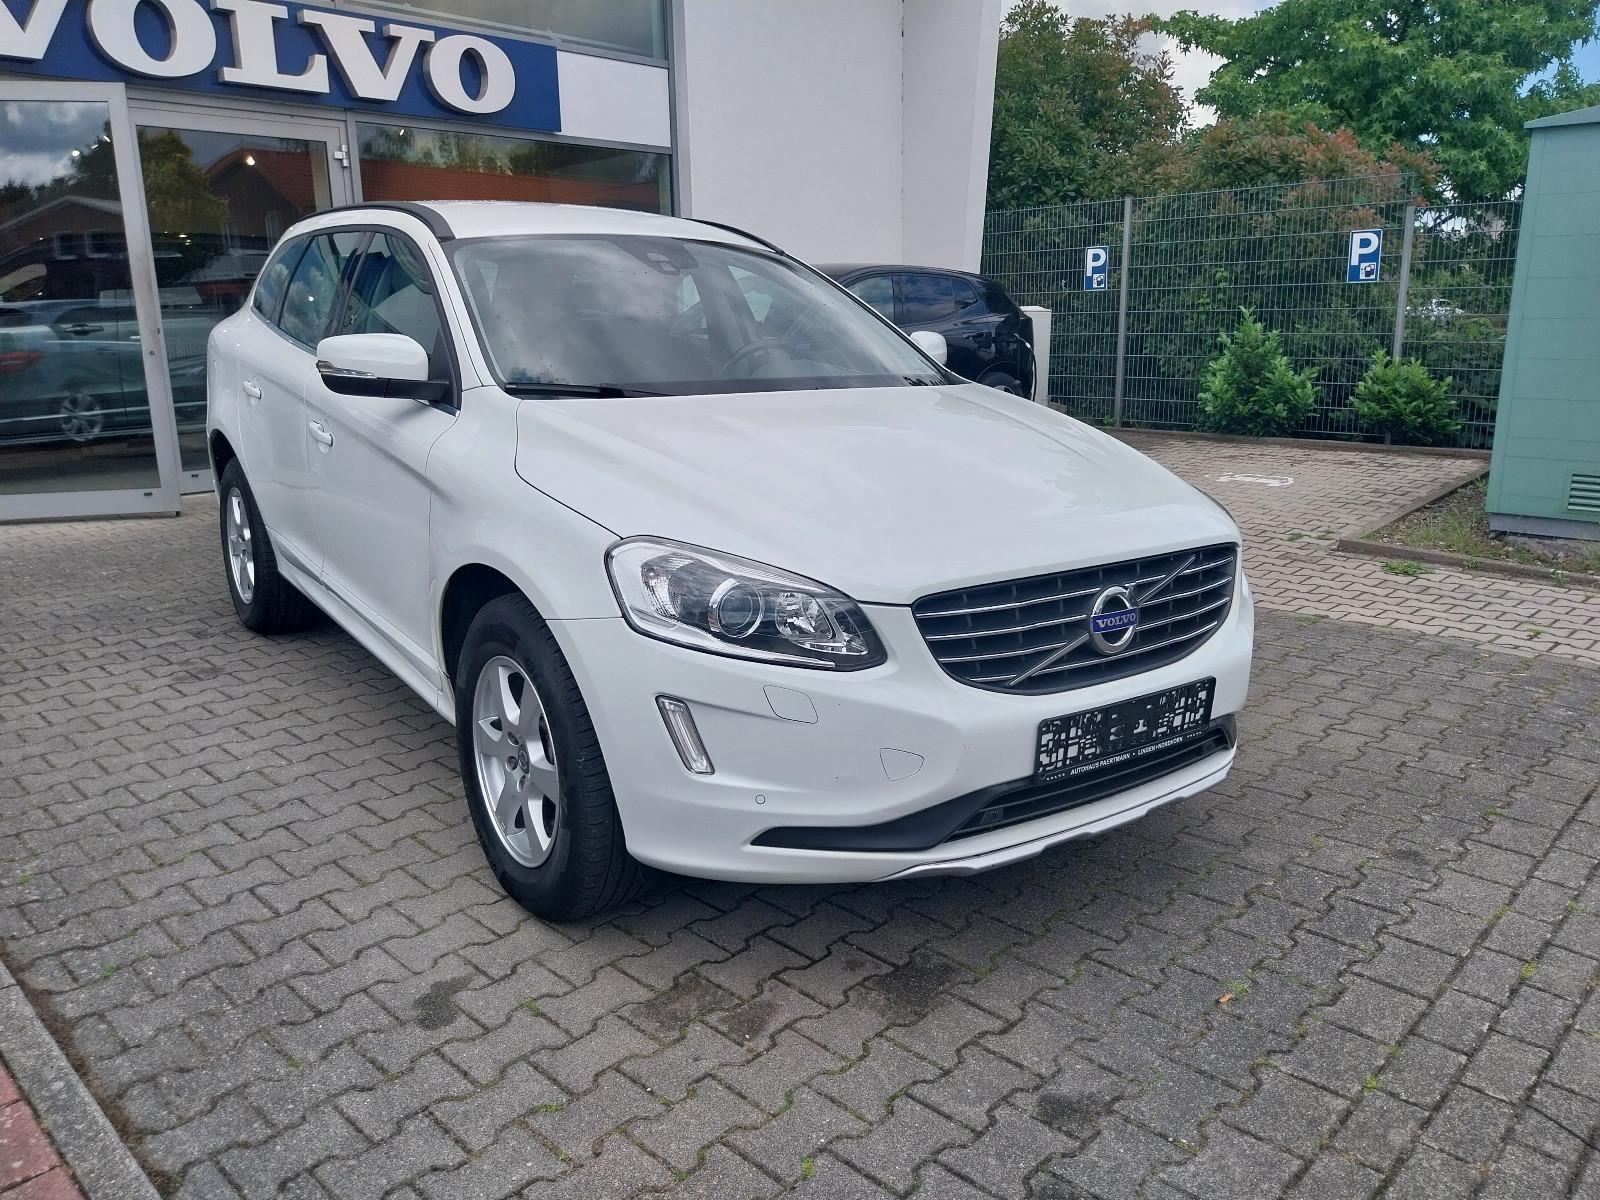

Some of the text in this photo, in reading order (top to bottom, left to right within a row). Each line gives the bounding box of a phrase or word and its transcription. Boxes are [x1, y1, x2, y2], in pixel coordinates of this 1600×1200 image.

[1351, 233, 1379, 266] P
[1086, 249, 1106, 277] P
[1096, 612, 1136, 628] VOLVO
[1070, 760, 1099, 776] AUTOHAUS
[1099, 752, 1131, 767] PAERTMANN
